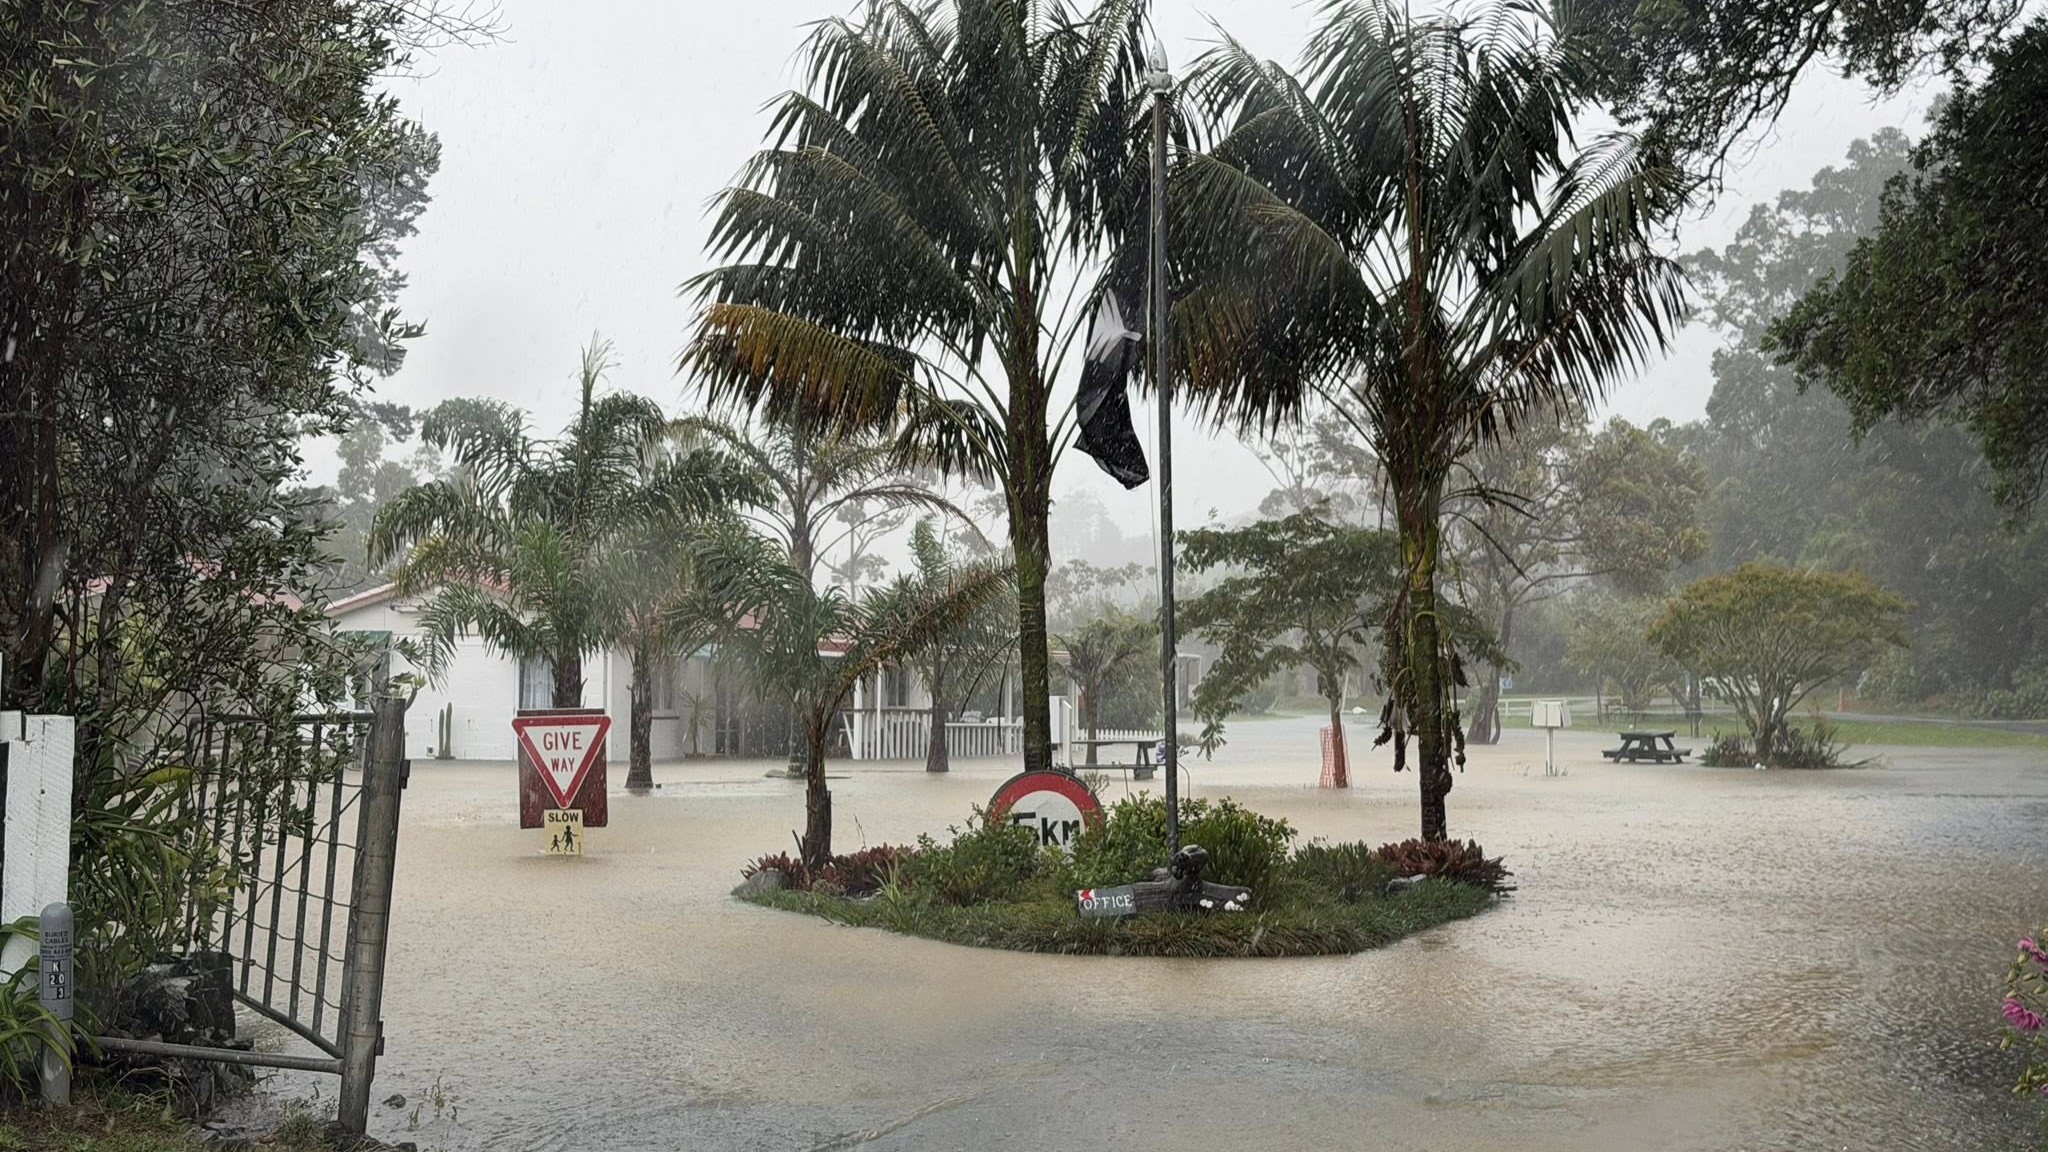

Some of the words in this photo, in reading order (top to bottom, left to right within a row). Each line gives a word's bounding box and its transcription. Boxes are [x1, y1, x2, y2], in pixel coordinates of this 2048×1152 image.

[543, 732, 582, 750] GIVE
[551, 757, 575, 772] WAY
[548, 812, 579, 823] SLOW
[1083, 895, 1132, 910] OFFICE
[53, 961, 60, 973] K
[58, 987, 64, 999] 3
